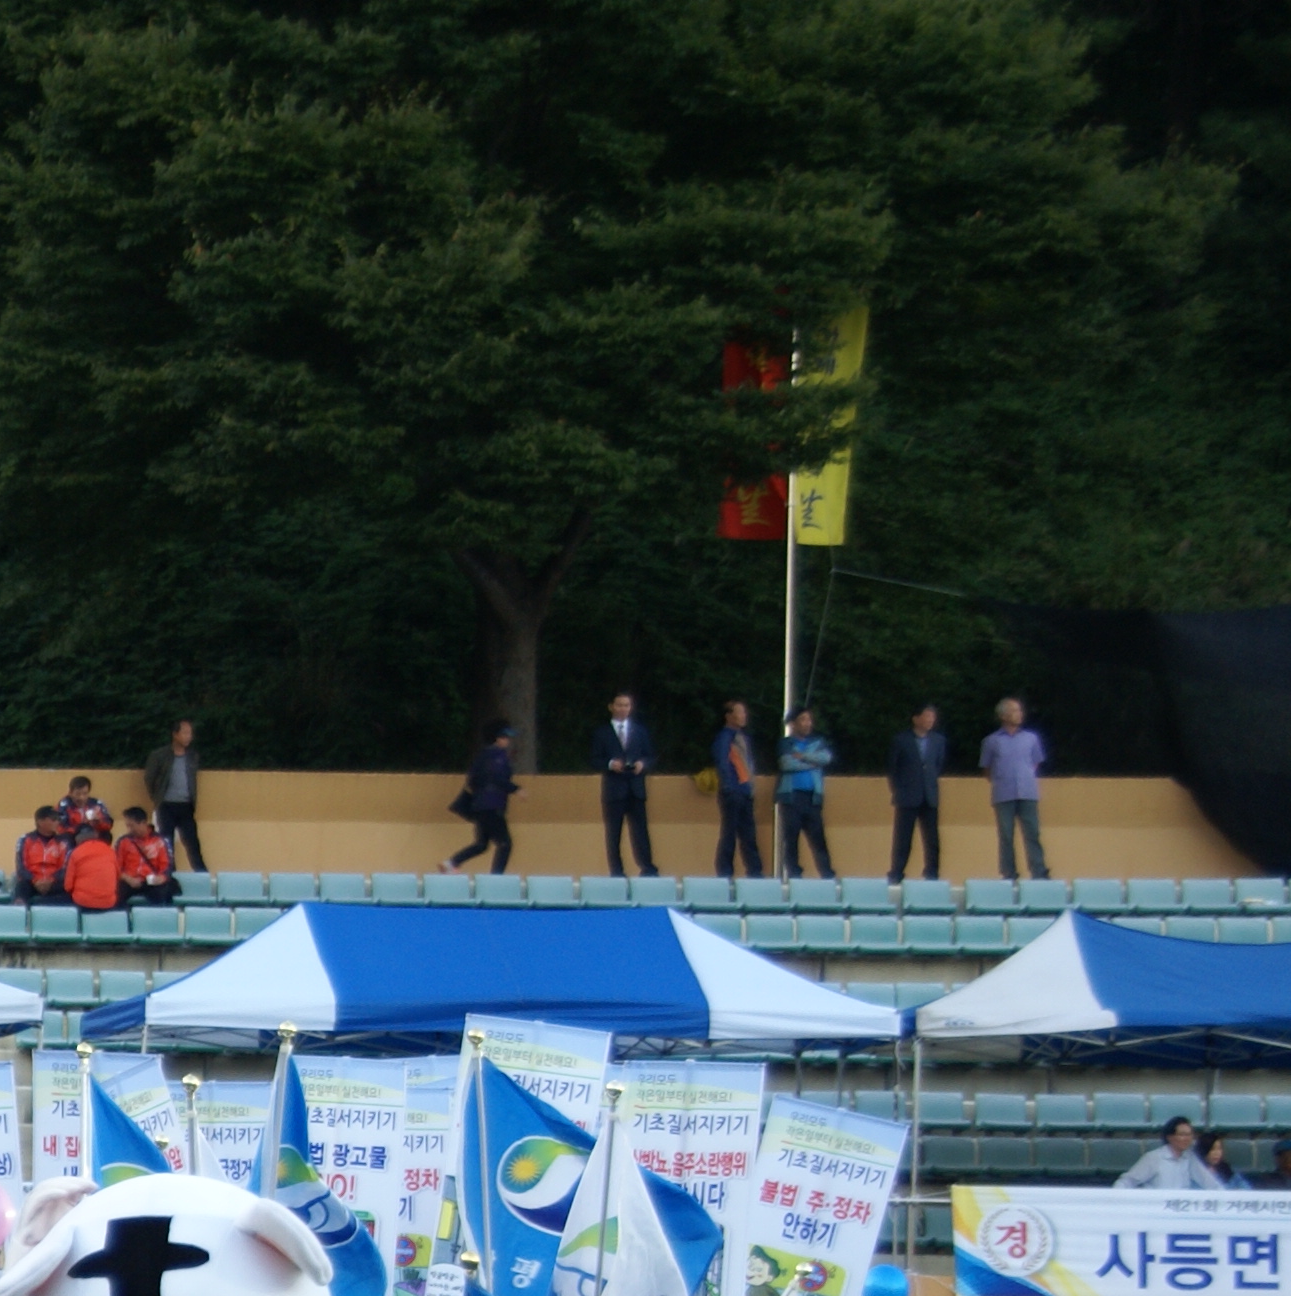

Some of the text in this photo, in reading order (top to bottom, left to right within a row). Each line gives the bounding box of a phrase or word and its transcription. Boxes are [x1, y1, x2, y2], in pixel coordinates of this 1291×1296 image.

[306, 1106, 397, 1131] 초질서지키기
[633, 1112, 749, 1136] 기초질서지키기
[43, 1135, 57, 1157] 내
[332, 1143, 388, 1170] 광고물
[778, 1148, 887, 1189] 기초질서지키기
[759, 1178, 799, 1208] 불법
[1164, 1198, 1218, 1214] 제21회
[781, 1211, 837, 1249] 안하기
[995, 1221, 1028, 1260] 경
[1095, 1231, 1281, 1291] 사등면
